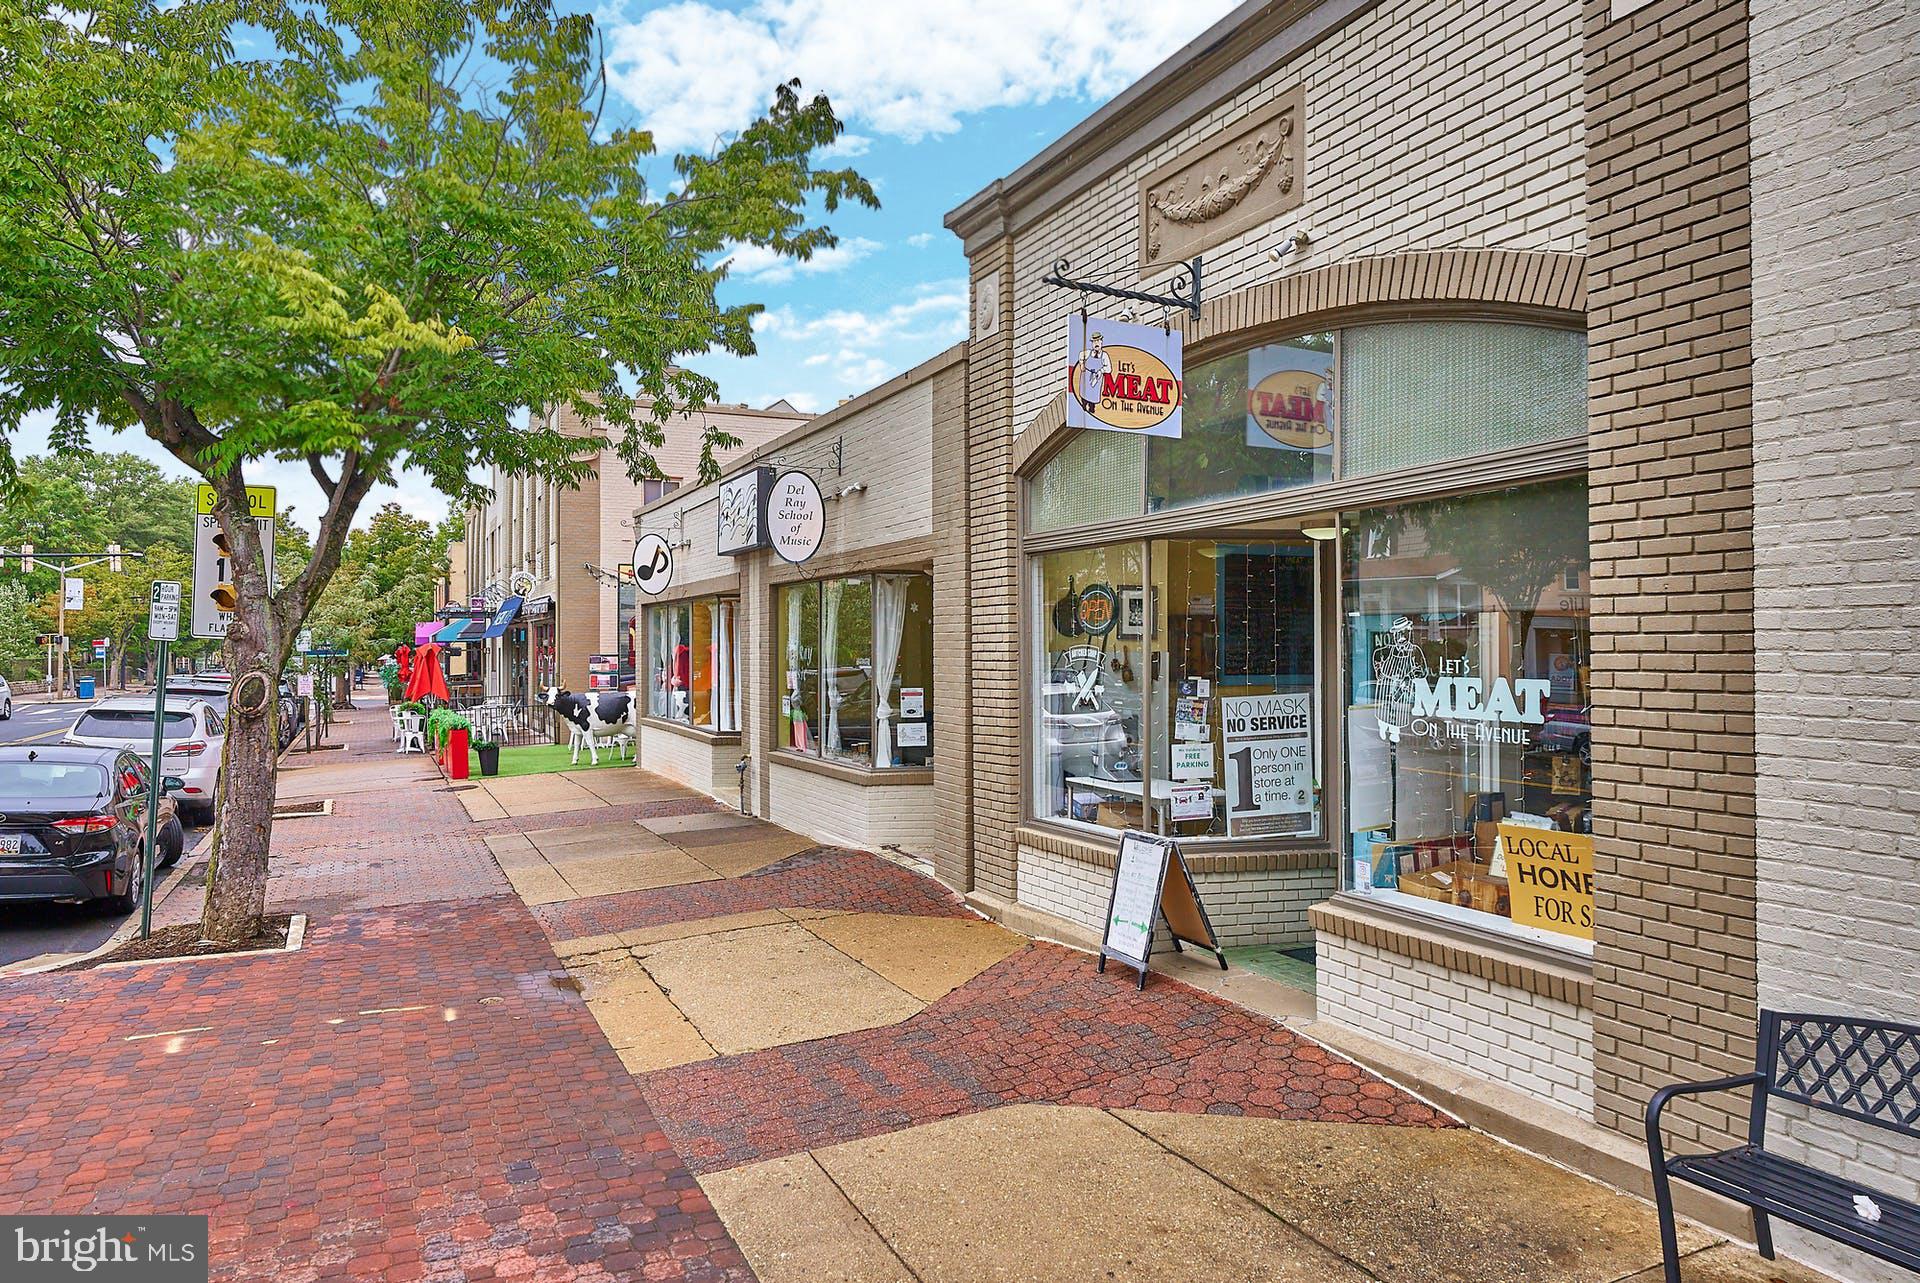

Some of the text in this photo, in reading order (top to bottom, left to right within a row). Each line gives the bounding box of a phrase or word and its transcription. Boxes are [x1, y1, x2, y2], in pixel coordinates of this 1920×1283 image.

[1102, 373, 1173, 404] MEAT
[1102, 398, 1164, 416] ON THE AVENUE
[787, 485, 805, 495] Del
[785, 498, 806, 510] Ray
[778, 510, 813, 521] School
[790, 523, 802, 535] of
[780, 536, 812, 546] Music
[153, 586, 160, 600] 2
[1080, 600, 1112, 622] OPEN
[1439, 656, 1471, 675] LET'S
[1411, 676, 1551, 724] MEAT
[1226, 698, 1306, 718] NO MASK
[1227, 718, 1246, 733] NO
[1250, 714, 1307, 731] SERVICE
[1411, 718, 1531, 745] ON THE AVENUE
[1185, 752, 1201, 760] FREE
[1252, 746, 1306, 761] Only ONE
[1176, 760, 1209, 769] PARKING
[1253, 761, 1304, 776] person in
[1229, 747, 1261, 812] 1
[1254, 776, 1295, 789] store at
[1254, 790, 1291, 803] a time.
[1505, 836, 1579, 864] LOCAL
[1534, 896, 1576, 925] FOR
